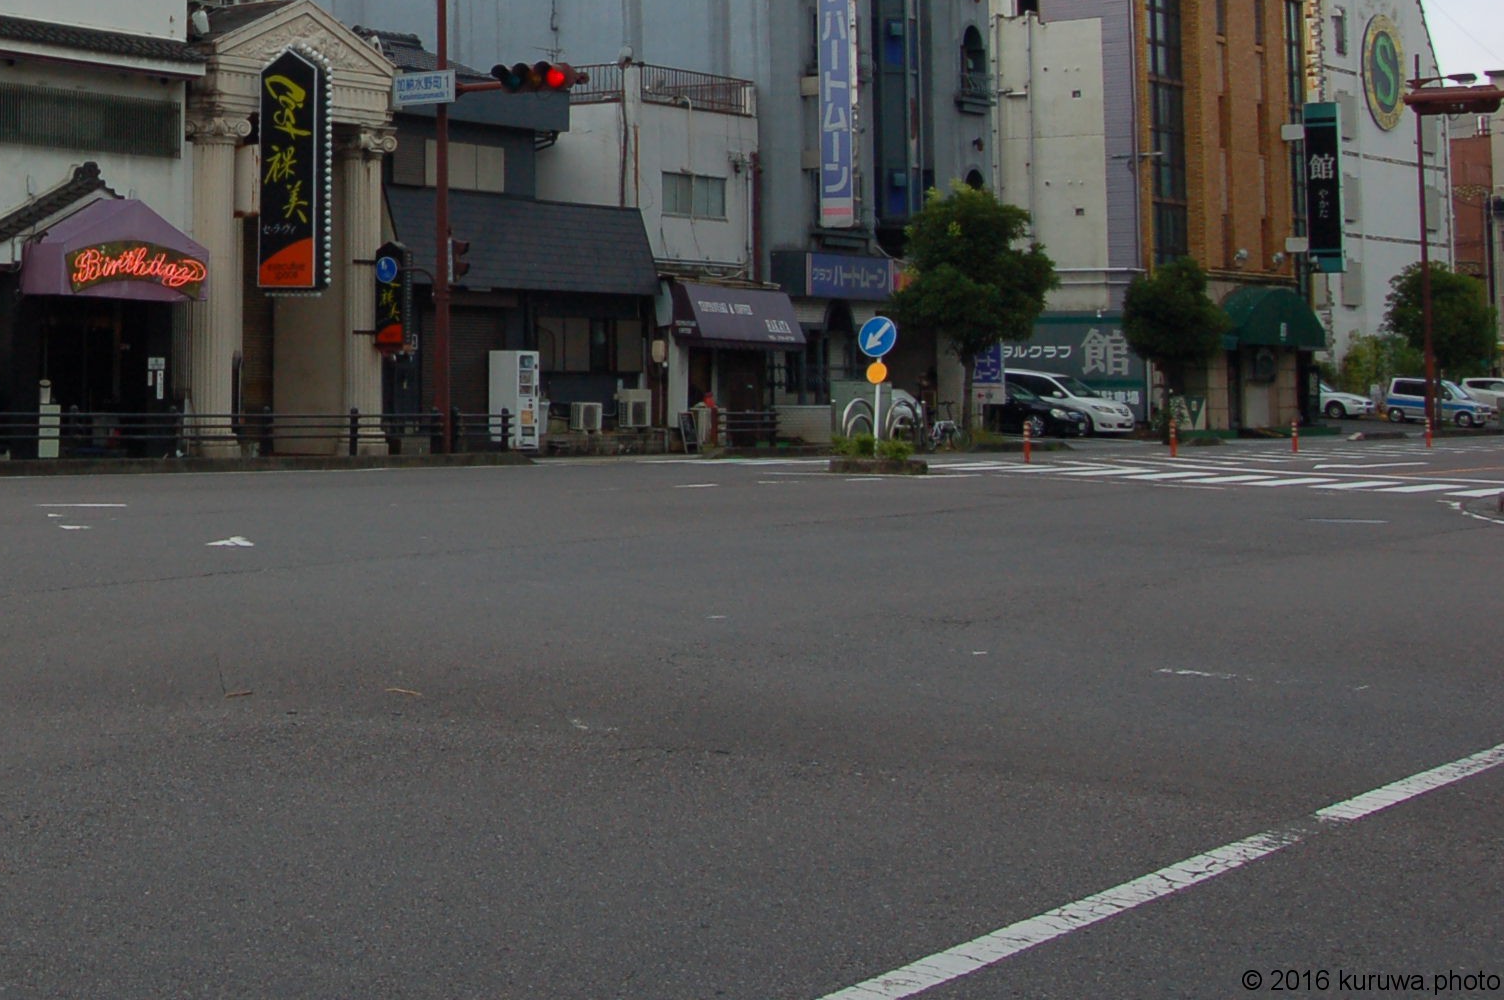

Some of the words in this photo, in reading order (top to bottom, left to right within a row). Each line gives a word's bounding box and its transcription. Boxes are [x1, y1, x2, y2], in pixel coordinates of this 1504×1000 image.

[822, 10, 849, 194] ハートムーン
[1308, 153, 1334, 180] 館
[72, 247, 207, 287] Birthday
[833, 265, 886, 289] ハートムーン
[1081, 328, 1130, 376] 館
